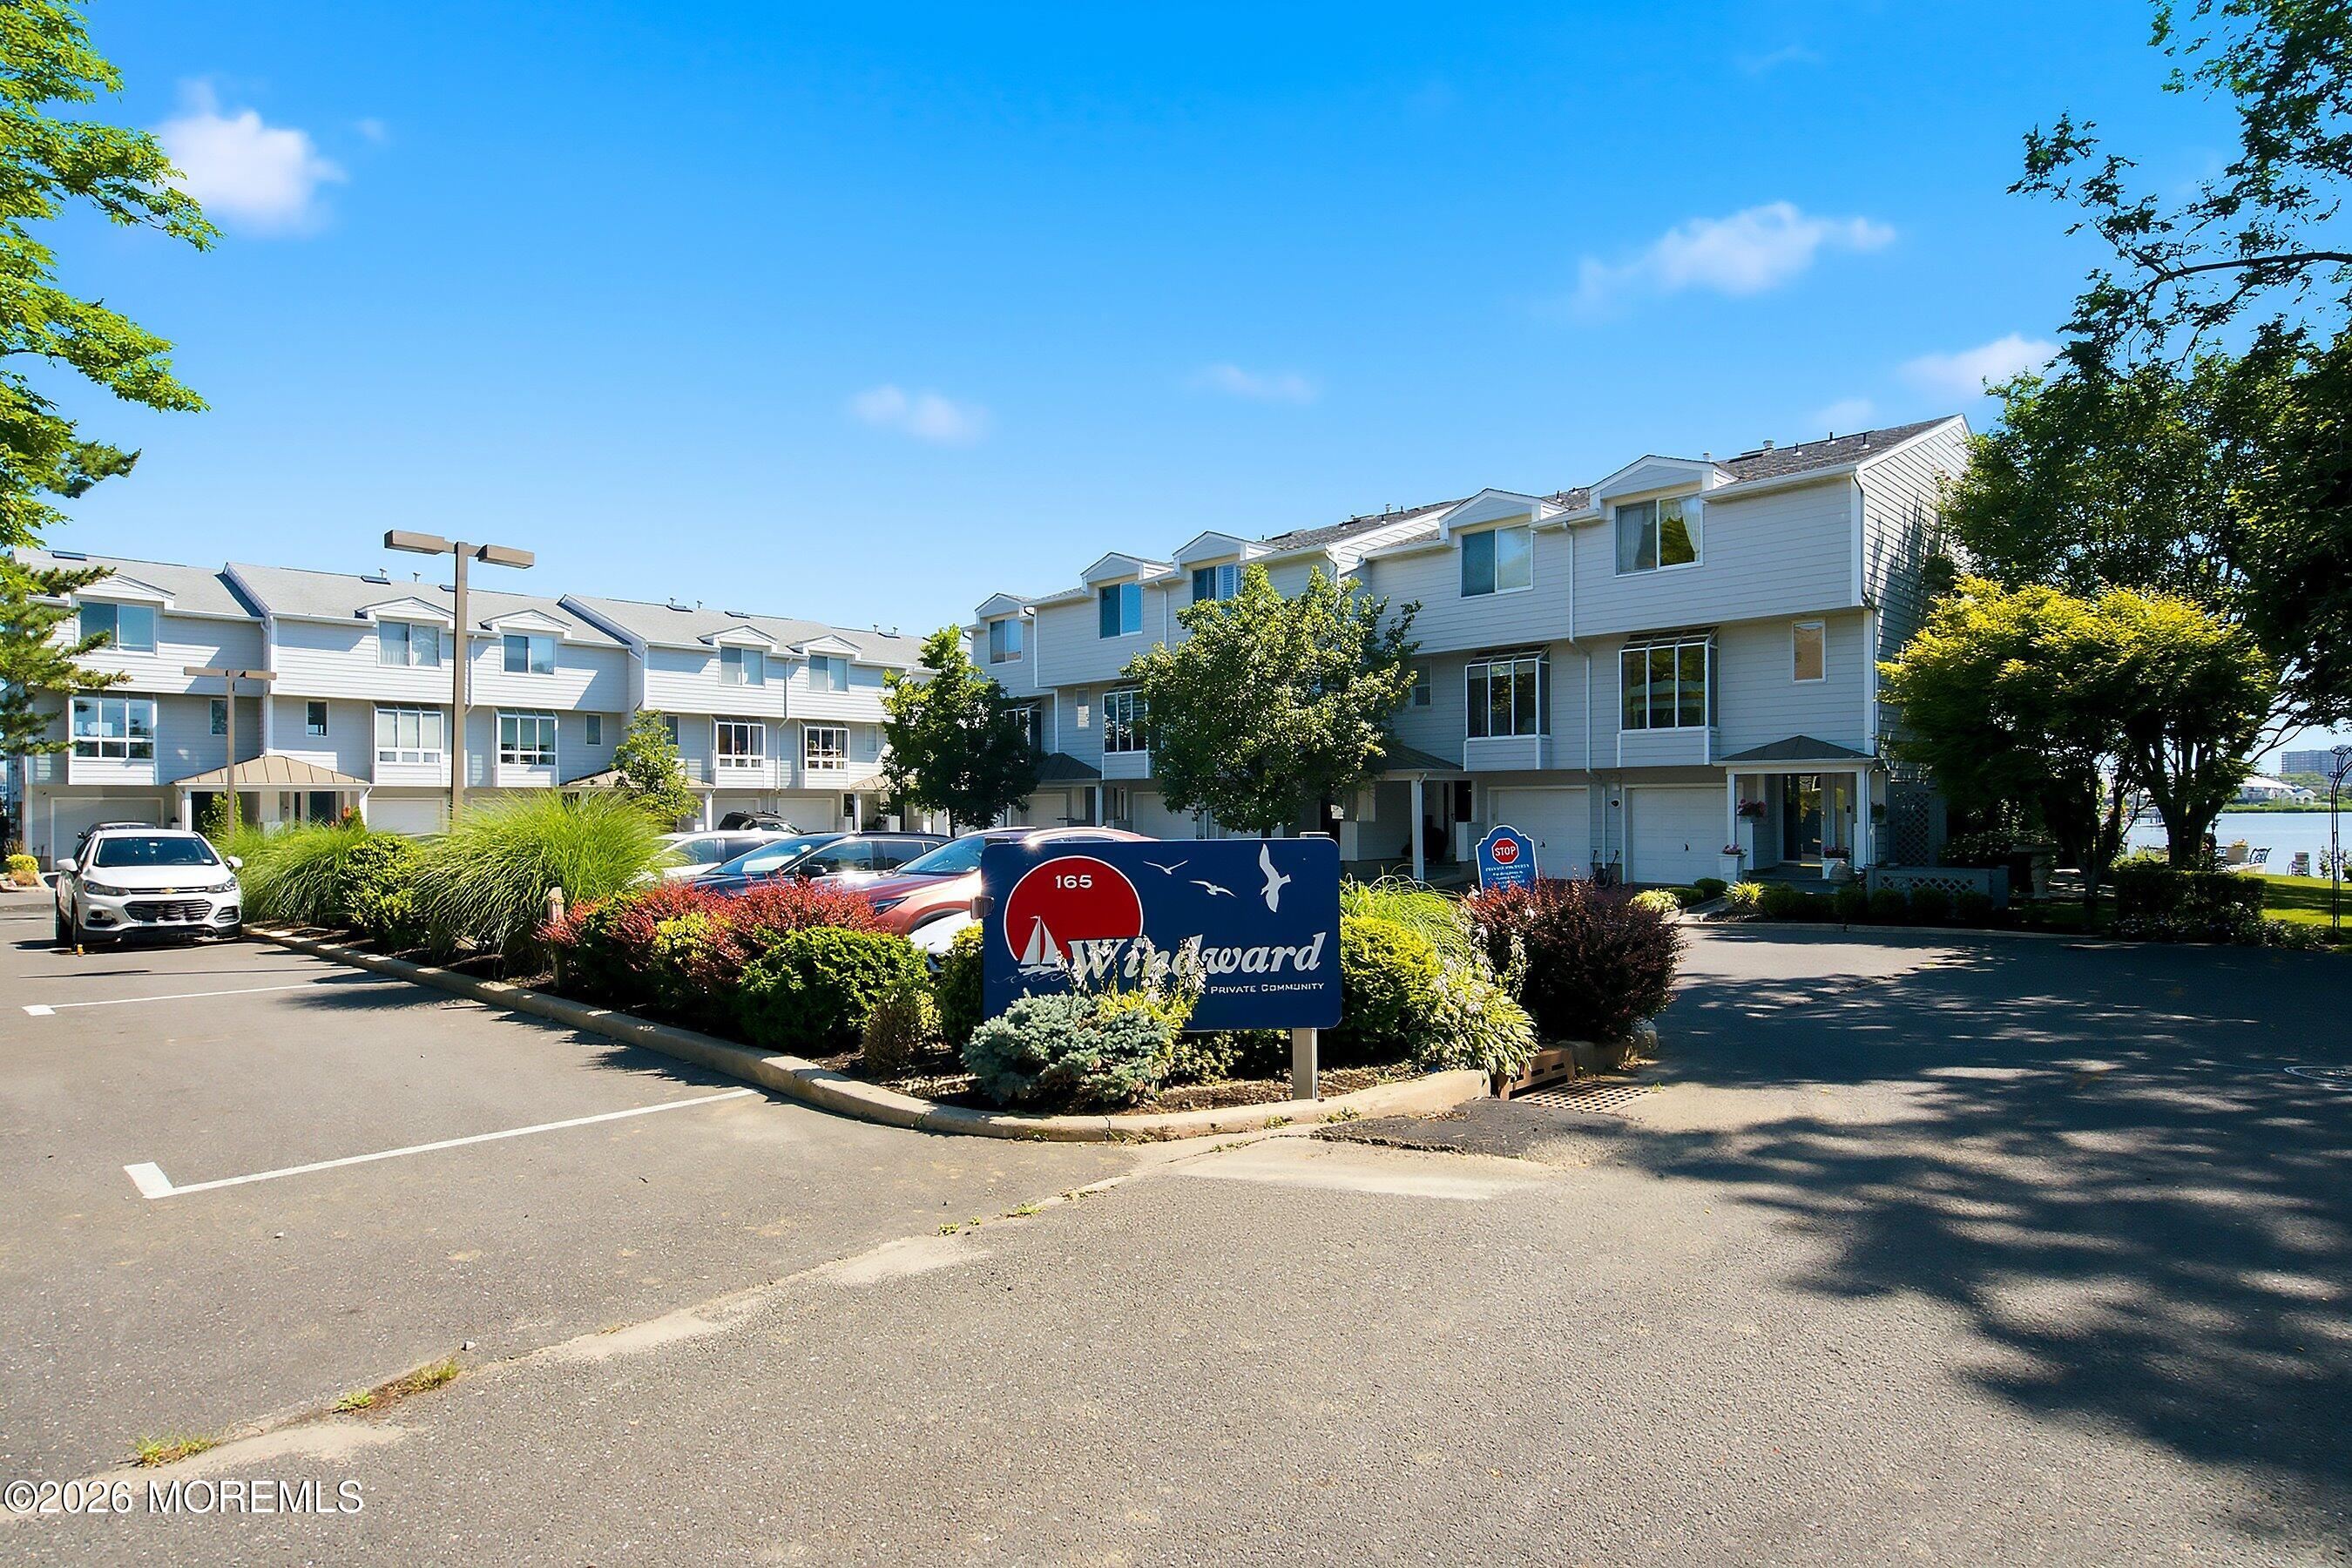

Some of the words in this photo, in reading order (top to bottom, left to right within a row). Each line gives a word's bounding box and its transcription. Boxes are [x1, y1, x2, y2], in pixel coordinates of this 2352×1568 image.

[1494, 846, 1516, 856] STOP
[1054, 874, 1093, 889] 165
[1067, 931, 1327, 979] Windward
[1210, 985, 1257, 994] PRIVATE
[1260, 983, 1325, 992] COMMUNITY
